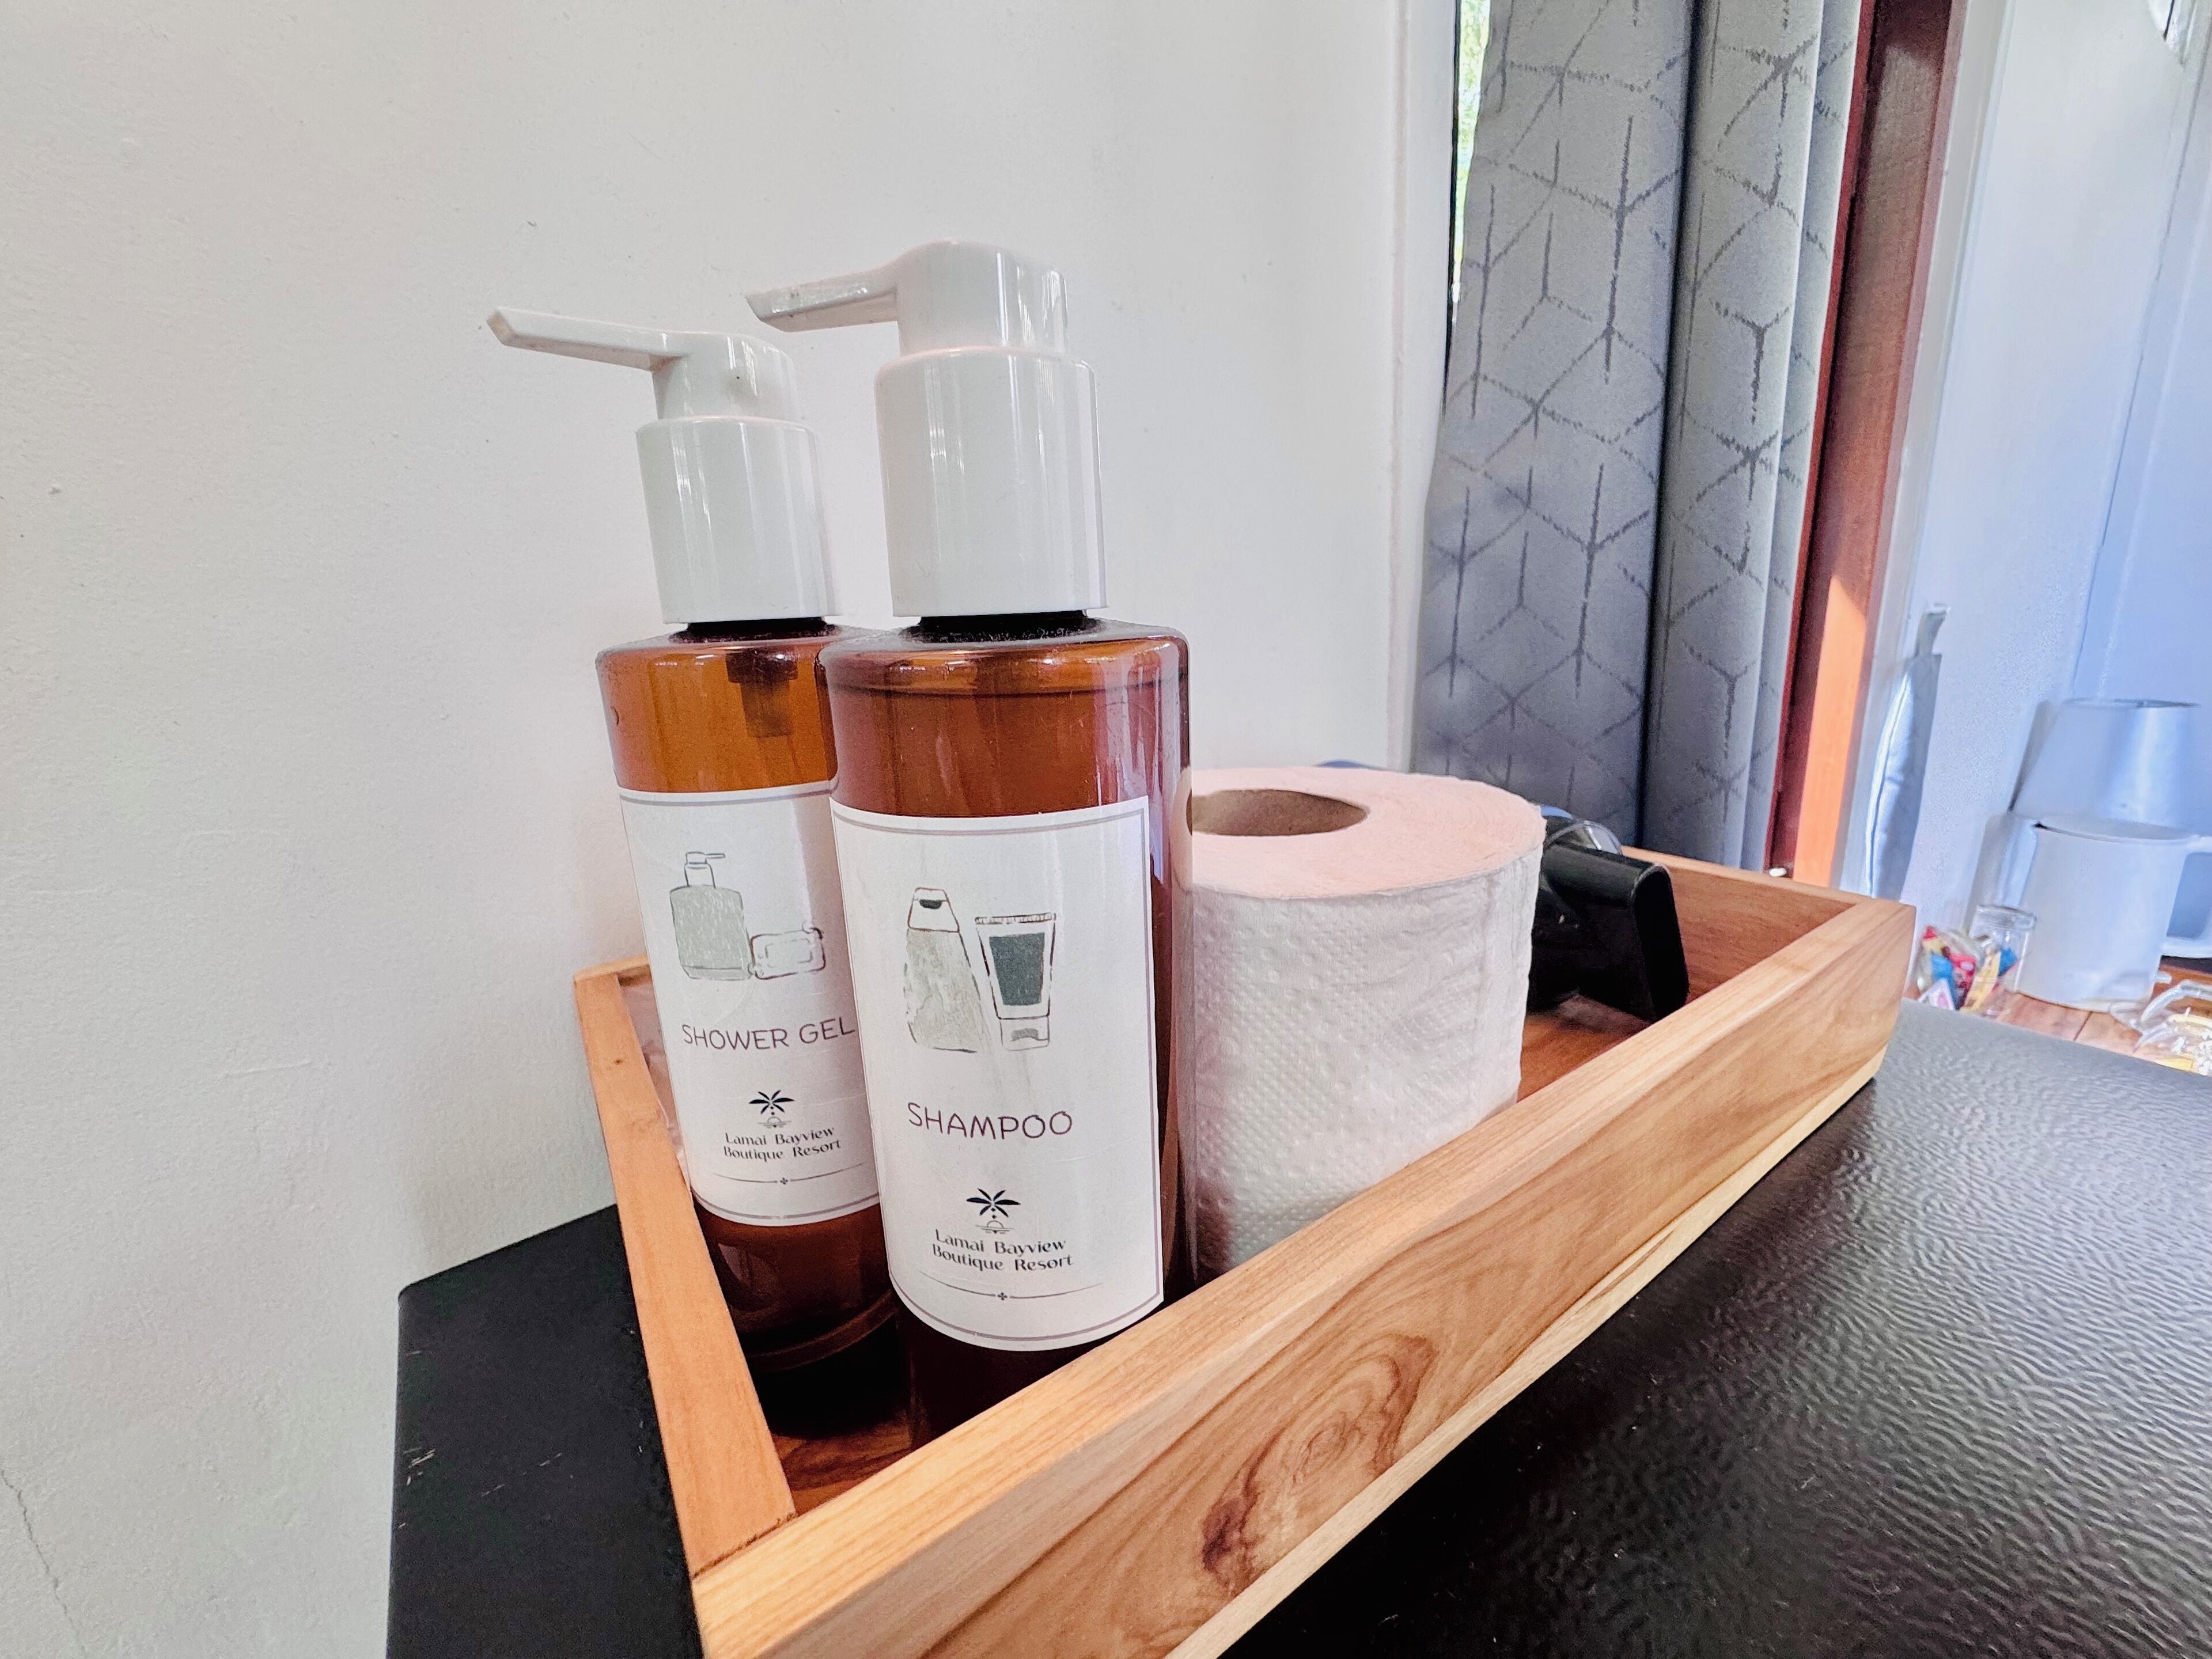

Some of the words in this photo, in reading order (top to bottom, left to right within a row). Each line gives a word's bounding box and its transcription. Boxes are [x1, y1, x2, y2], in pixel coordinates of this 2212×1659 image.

[681, 1024, 790, 1050] SHOWER
[799, 1017, 856, 1044] GEL
[907, 1101, 1073, 1139] SHAMPOO
[724, 1132, 767, 1146] Lamai
[775, 1127, 835, 1145] Bayview
[724, 1146, 783, 1162] Boutique
[793, 1138, 842, 1158] Resort
[934, 1228, 984, 1253] Lamai
[994, 1240, 1066, 1257] Bayview
[932, 1243, 1003, 1271] Boutique
[1014, 1253, 1074, 1271] Resort
